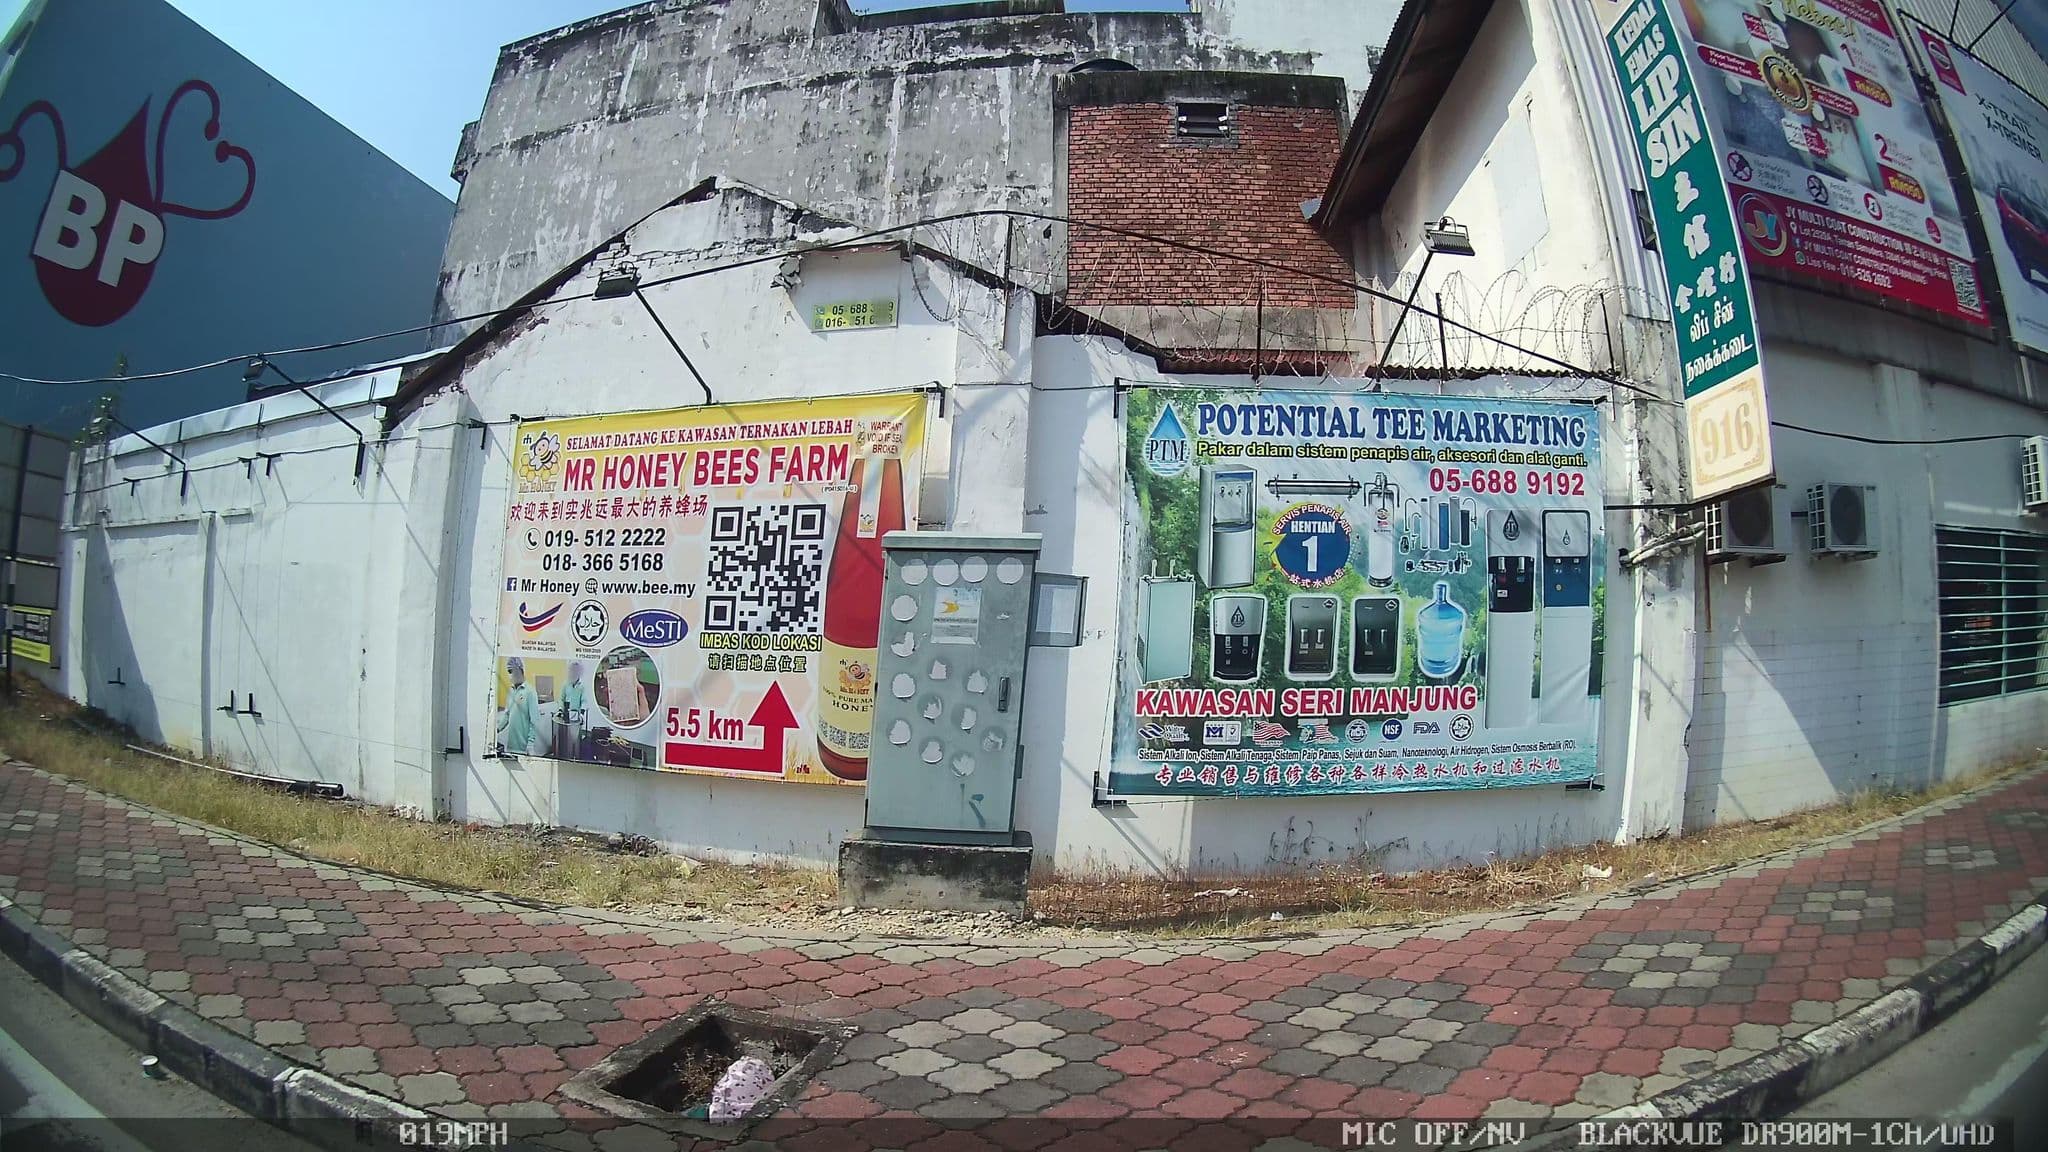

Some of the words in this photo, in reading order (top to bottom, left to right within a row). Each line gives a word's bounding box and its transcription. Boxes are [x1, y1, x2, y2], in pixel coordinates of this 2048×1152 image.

[1613, 0, 1657, 57] KEDAI
[1625, 23, 1666, 84] EMAS
[1630, 54, 1680, 134] LIP
[1975, 92, 2036, 141] X-TRAIL
[1647, 93, 1701, 178] SIN
[33, 169, 164, 288] BP
[850, 303, 868, 315] 688
[566, 434, 612, 450] SELAMAT
[615, 431, 658, 447] DATANG
[661, 430, 676, 444] KE
[678, 424, 737, 443] KAWASAN
[740, 421, 808, 440] TERNAKAN
[811, 419, 853, 436] LEBAH
[1198, 403, 1366, 438] POTENTIAL
[1373, 408, 1426, 440] TEE
[1432, 410, 1586, 447] MARKETING
[1701, 402, 1754, 465] 916
[1149, 438, 1186, 461] PTM
[1197, 441, 1243, 457] Pakar
[1245, 442, 1292, 458] dalam
[1296, 443, 1347, 459] sistem
[1350, 445, 1409, 464] penapis
[1411, 447, 1435, 463] air,
[1437, 448, 1496, 463] aksesori
[1498, 451, 1524, 465] dan
[1526, 452, 1550, 466] alat
[1551, 453, 1588, 470] ganti.
[564, 458, 595, 491] MR
[602, 452, 687, 490] HONEY
[693, 449, 759, 485] BEES
[769, 444, 849, 483] FARM
[1429, 467, 1518, 494] 05-688
[1527, 471, 1585, 496] 9192
[510, 494, 708, 522] 欢迎来到实兆远最大的养蜂场
[1272, 508, 1301, 535] SERVIS
[1301, 504, 1341, 521] PENAPIS
[1337, 518, 1352, 535] AIR
[544, 529, 579, 548] 019-
[584, 528, 615, 547] 512
[620, 527, 666, 547] 2222
[1290, 520, 1336, 534] HENTIAN
[542, 553, 577, 571] 018-
[582, 553, 613, 571] 366
[619, 553, 664, 571] 5168
[1301, 535, 1318, 572] 1
[521, 578, 537, 593] Mr
[540, 579, 580, 596] Honey
[602, 581, 696, 598] www.bee.my
[625, 620, 682, 640] MeSTI
[700, 632, 740, 649] IMBAS
[743, 633, 770, 650] KOD
[772, 634, 822, 651] LOKASI
[707, 653, 807, 673] 请扫描地点位置
[832, 699, 874, 713] HONE
[1136, 689, 1274, 716] KAWASAN
[1281, 688, 1342, 715] SERI
[1351, 686, 1477, 714] MANJUNG
[666, 707, 701, 737] 5.5
[709, 710, 744, 741] km
[1384, 724, 1400, 735] NSF
[1413, 722, 1440, 734] FDA
[1138, 750, 1163, 760] Sistem
[1164, 749, 1185, 760] Alkali
[1200, 750, 1224, 760] Sistem
[1225, 749, 1246, 760] Alkali
[1247, 749, 1274, 763] Tenaga,
[1275, 750, 1299, 760] Sistem
[1301, 750, 1319, 761] Paip
[1319, 750, 1342, 760] Panas,
[1344, 749, 1364, 761] Sejuk
[1365, 748, 1376, 759] dan
[1378, 749, 1399, 760] Suam,
[1402, 747, 1449, 760] Nanoteknologi,
[1450, 746, 1460, 755] Air
[1461, 745, 1489, 757] Hidrogen,
[1491, 744, 1512, 754] Sistem
[1513, 743, 1538, 753] Osmosis
[1539, 741, 1562, 752] Berbalik
[1155, 756, 1561, 787] 专业销售与维修各种各样冷热水机和过滤水机
